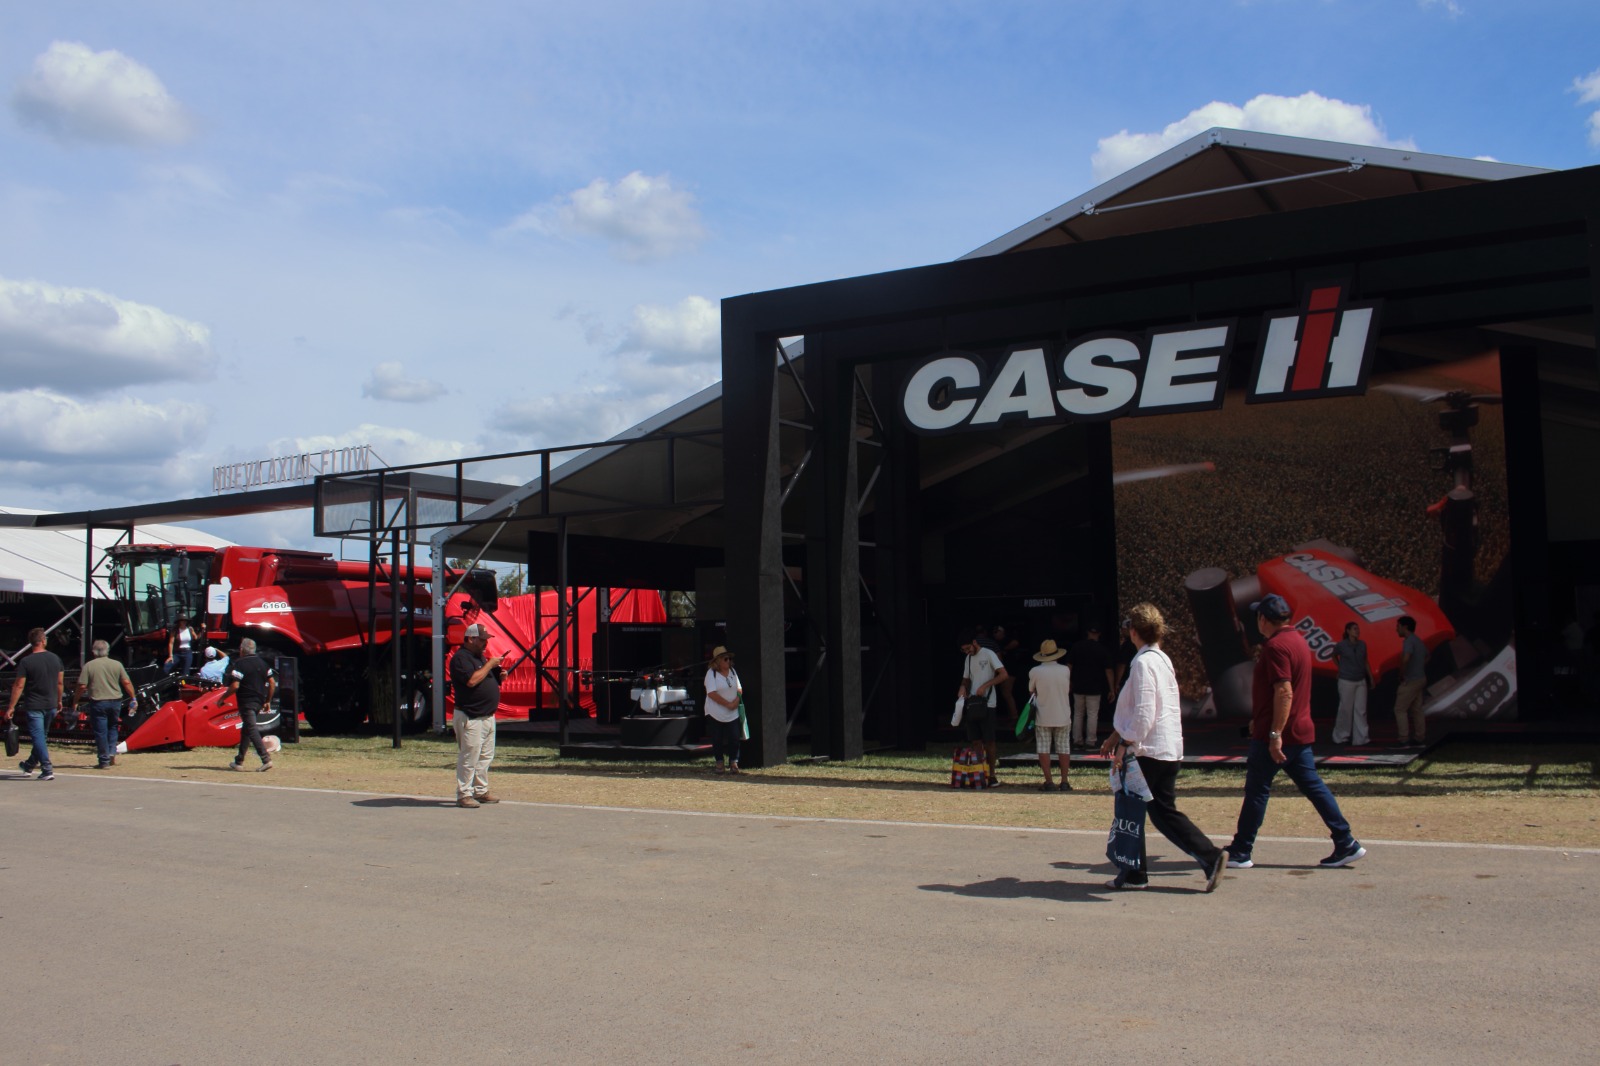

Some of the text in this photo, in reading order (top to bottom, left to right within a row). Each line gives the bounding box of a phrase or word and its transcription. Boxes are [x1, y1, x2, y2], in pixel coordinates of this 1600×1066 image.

[903, 326, 1229, 430] CASE
[212, 444, 371, 492] NUEVA AXIAL FLOW
[1284, 553, 1369, 596] CASE
[1294, 615, 1337, 662] P150
[1118, 818, 1140, 835] UCA
